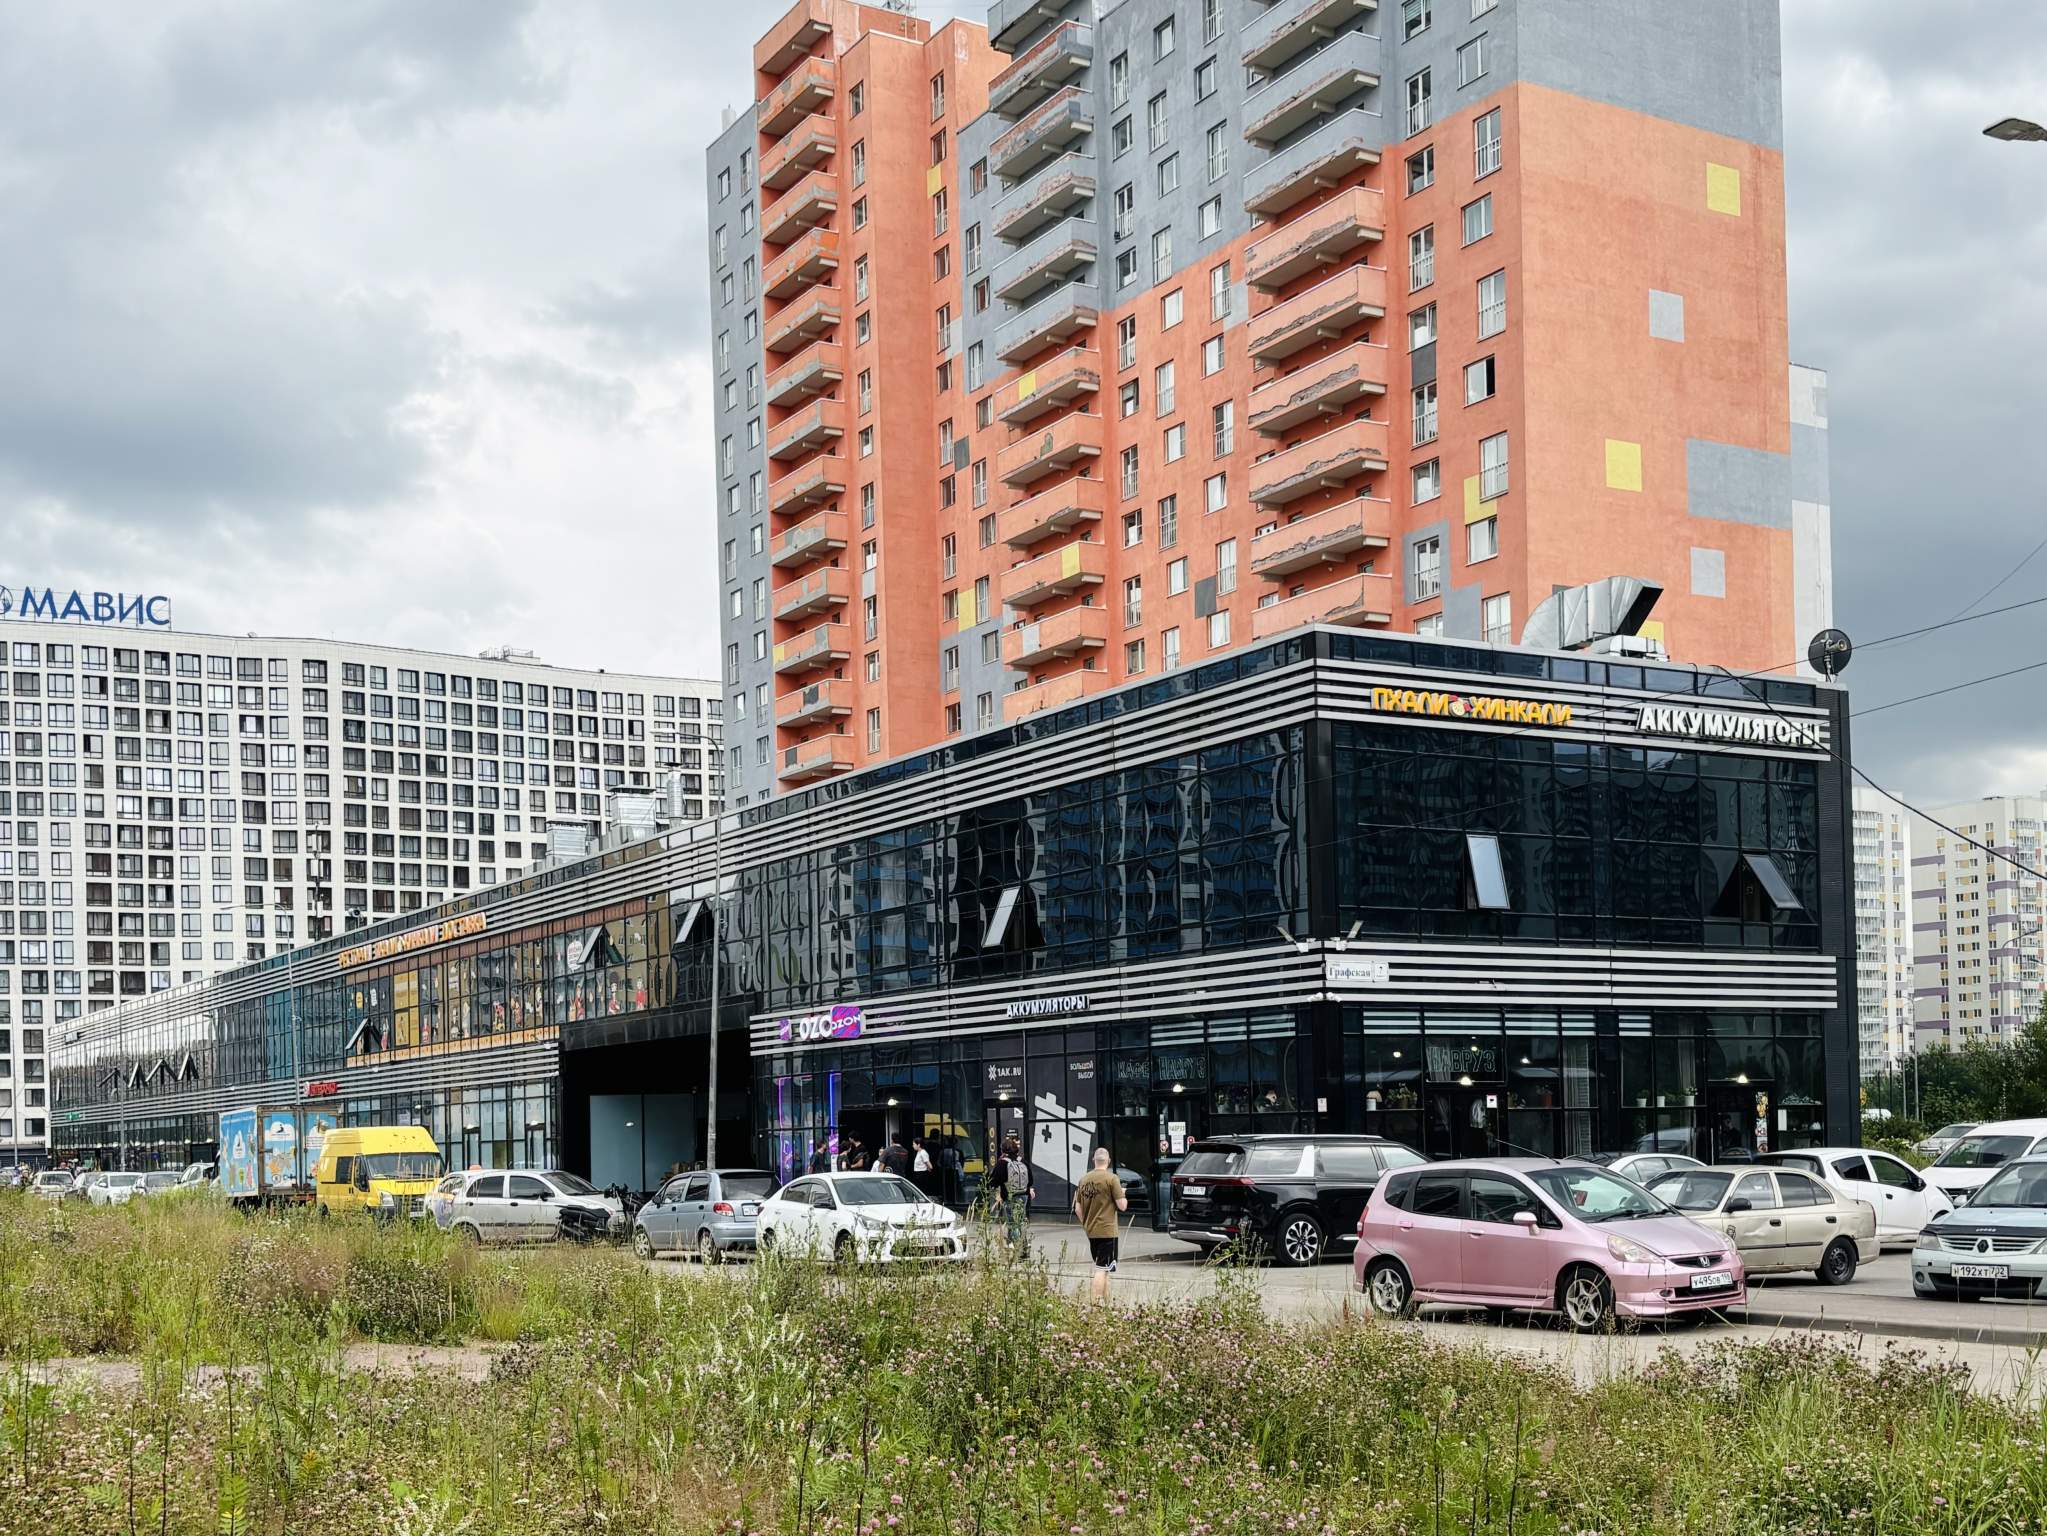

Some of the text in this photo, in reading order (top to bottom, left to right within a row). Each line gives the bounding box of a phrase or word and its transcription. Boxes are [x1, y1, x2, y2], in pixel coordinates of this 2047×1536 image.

[19, 586, 170, 626] МАВИС
[1371, 687, 1572, 726] ПХАЛИ ХИНКАЛИ
[1636, 707, 1820, 744] АККУМУЛЯТОРЫ
[1329, 967, 1371, 980] Графская
[1007, 995, 1088, 1017] АККУМУЛЯТОРЫ
[800, 1014, 832, 1040] OZO
[831, 1014, 861, 1030] OZON
